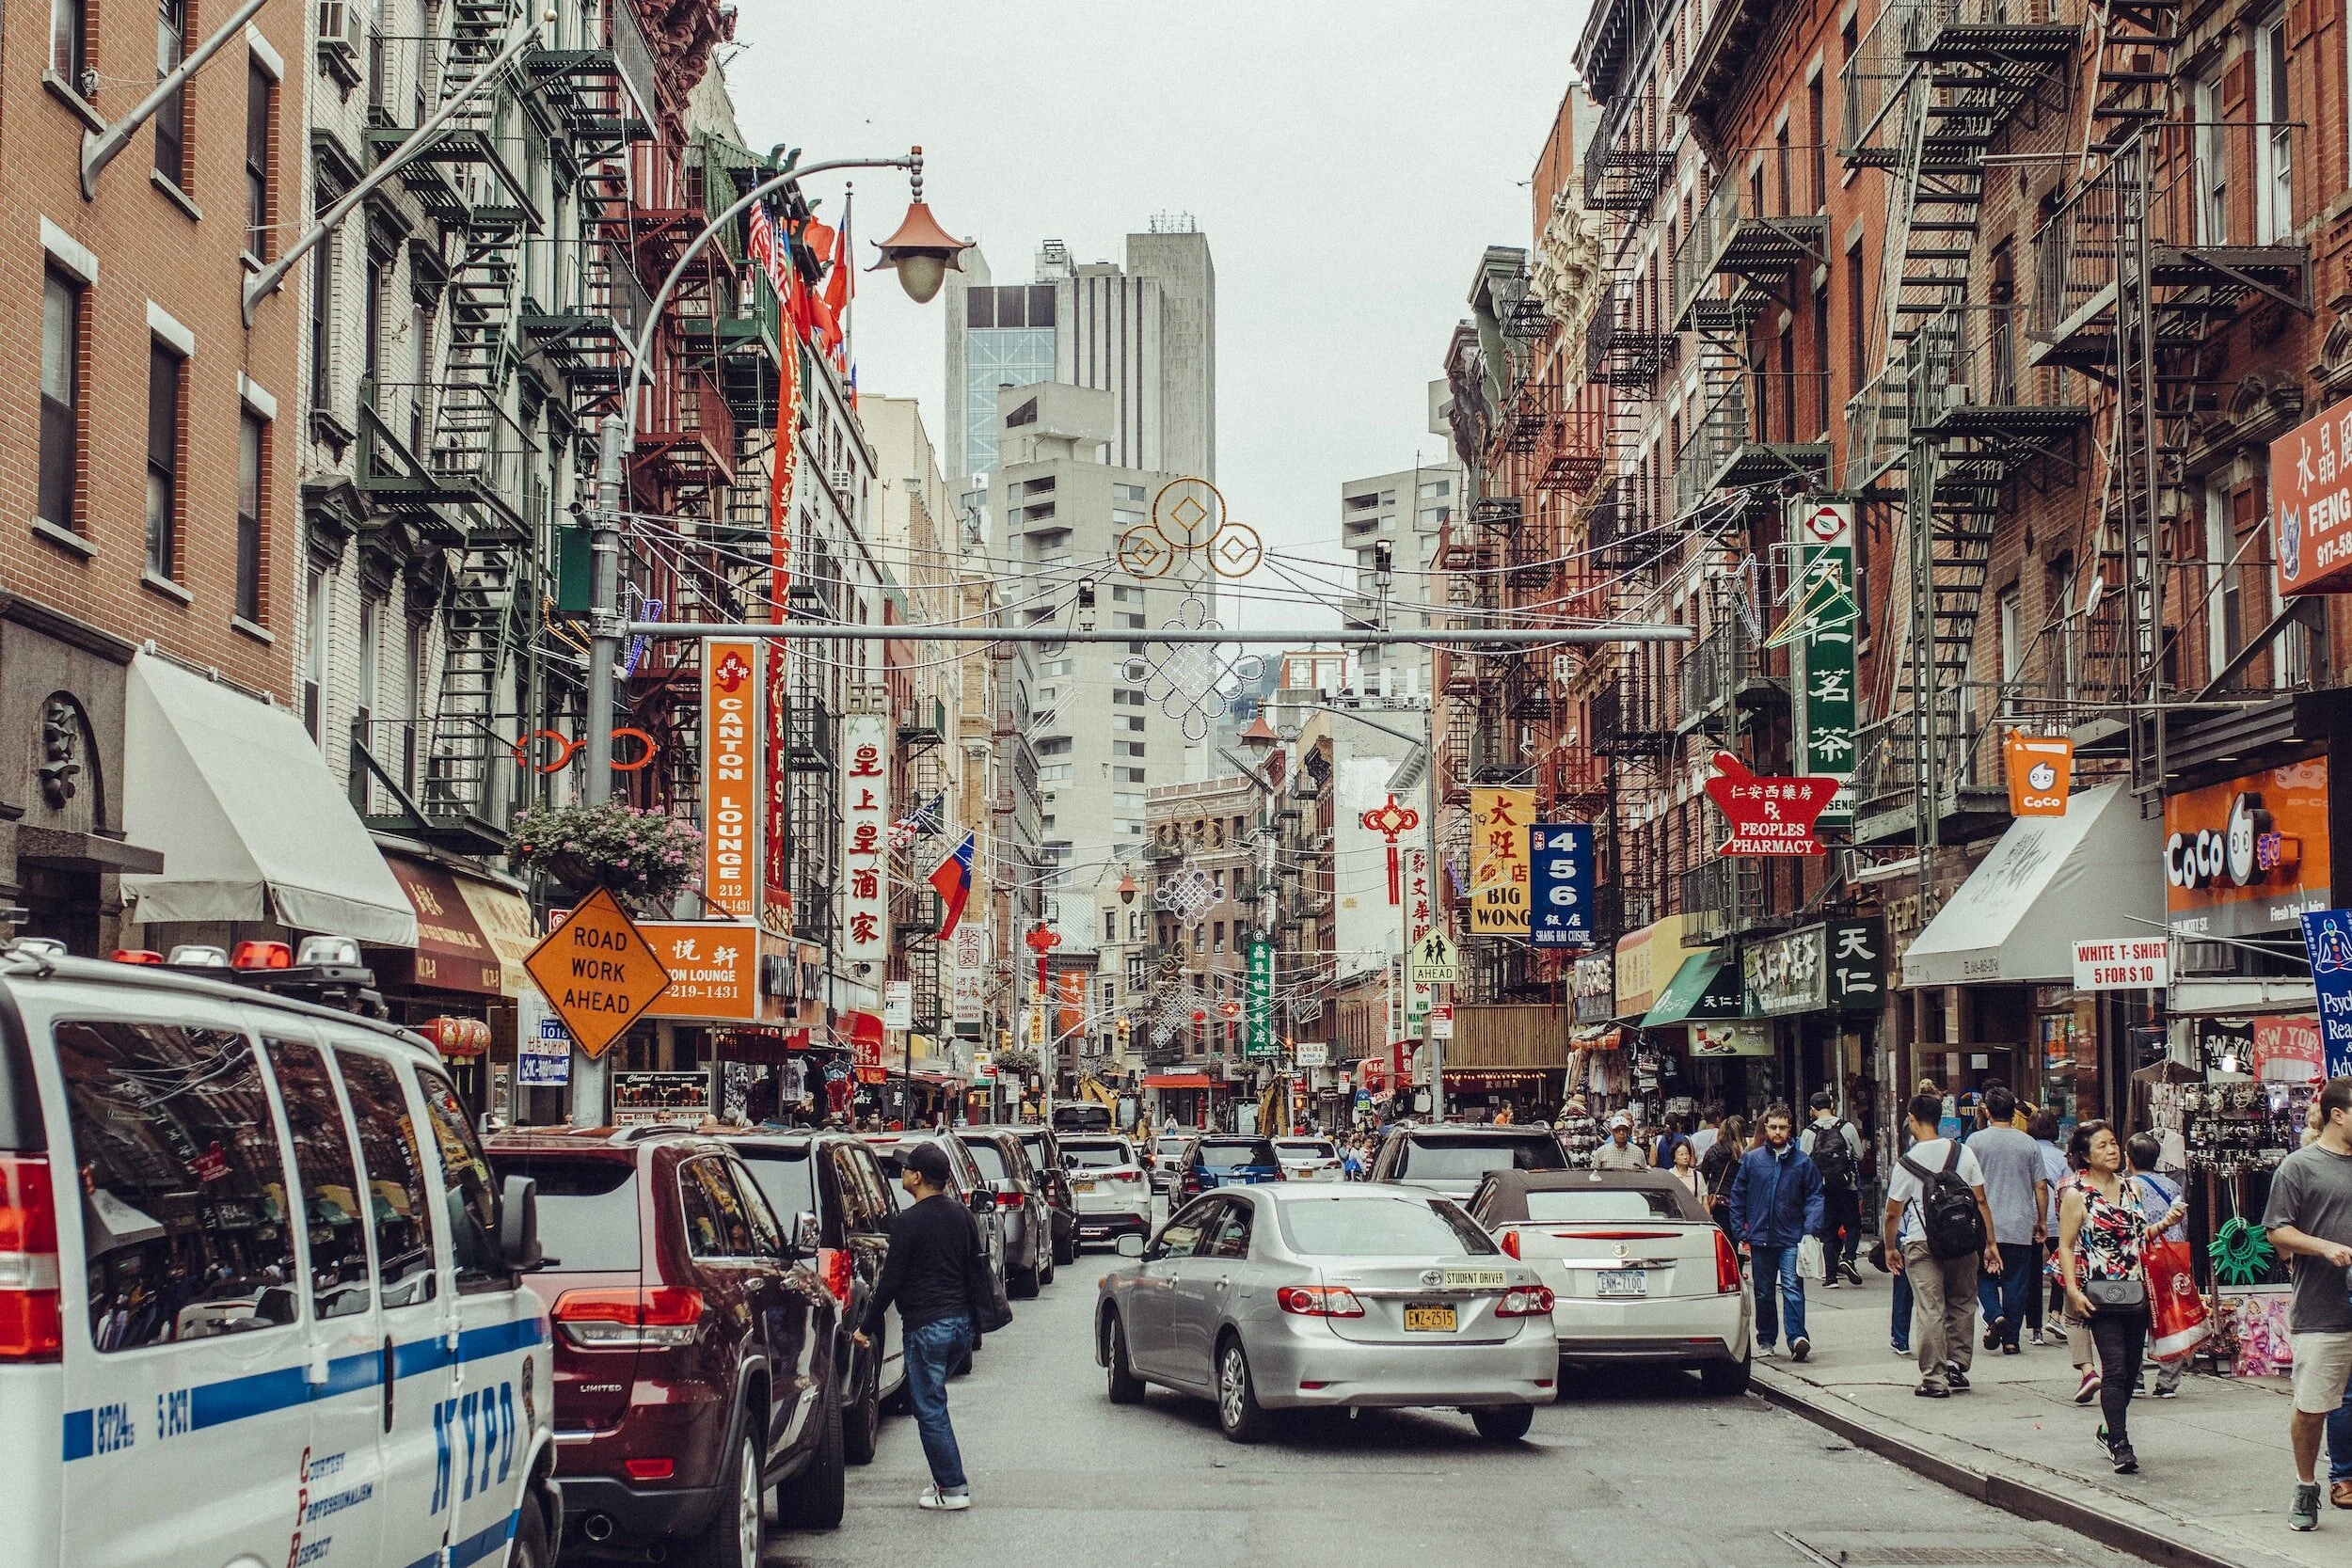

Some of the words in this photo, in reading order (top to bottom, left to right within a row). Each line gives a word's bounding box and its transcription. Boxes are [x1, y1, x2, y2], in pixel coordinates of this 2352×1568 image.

[2309, 487, 2350, 537] FENG
[718, 698, 743, 781] CANTON
[1730, 784, 1813, 800] 仁安西藥房
[717, 797, 743, 879] LOUNGE
[1490, 796, 1518, 860] 大旺
[1740, 823, 1806, 836] PEOPLES
[849, 742, 883, 945] 皇上皇酒家
[1732, 839, 1815, 854] PHARMACY
[719, 884, 742, 896] 212
[1487, 887, 1520, 905] BIG
[1477, 909, 1532, 927] WONG
[574, 927, 628, 952] ROAD
[1535, 930, 1555, 942] SHANG
[1556, 930, 1567, 942] HAI
[1568, 929, 1591, 942] CUISINE
[1835, 927, 1878, 996] 天仁
[2078, 945, 2115, 962] WHITE
[2133, 942, 2168, 959] SHIRT
[572, 958, 626, 983] WORK
[690, 969, 736, 983] LOUNGE
[1417, 968, 1454, 979] AHEAD
[2094, 968, 2103, 984] 5
[2105, 967, 2126, 984] FOR
[2139, 966, 2153, 982] 10
[564, 989, 630, 1015] AHEAD
[1416, 1001, 1429, 1011] NEW
[1446, 1272, 1478, 1284] STUDENT
[1478, 1272, 1504, 1284] DRIVER
[580, 1384, 622, 1393] LIMITED
[168, 1388, 188, 1437] PCT
[430, 1381, 515, 1517] NYPD
[300, 1446, 345, 1483] COURTESY
[296, 1482, 373, 1528] PROFESSIONALISM
[286, 1531, 332, 1568] RESPECT
